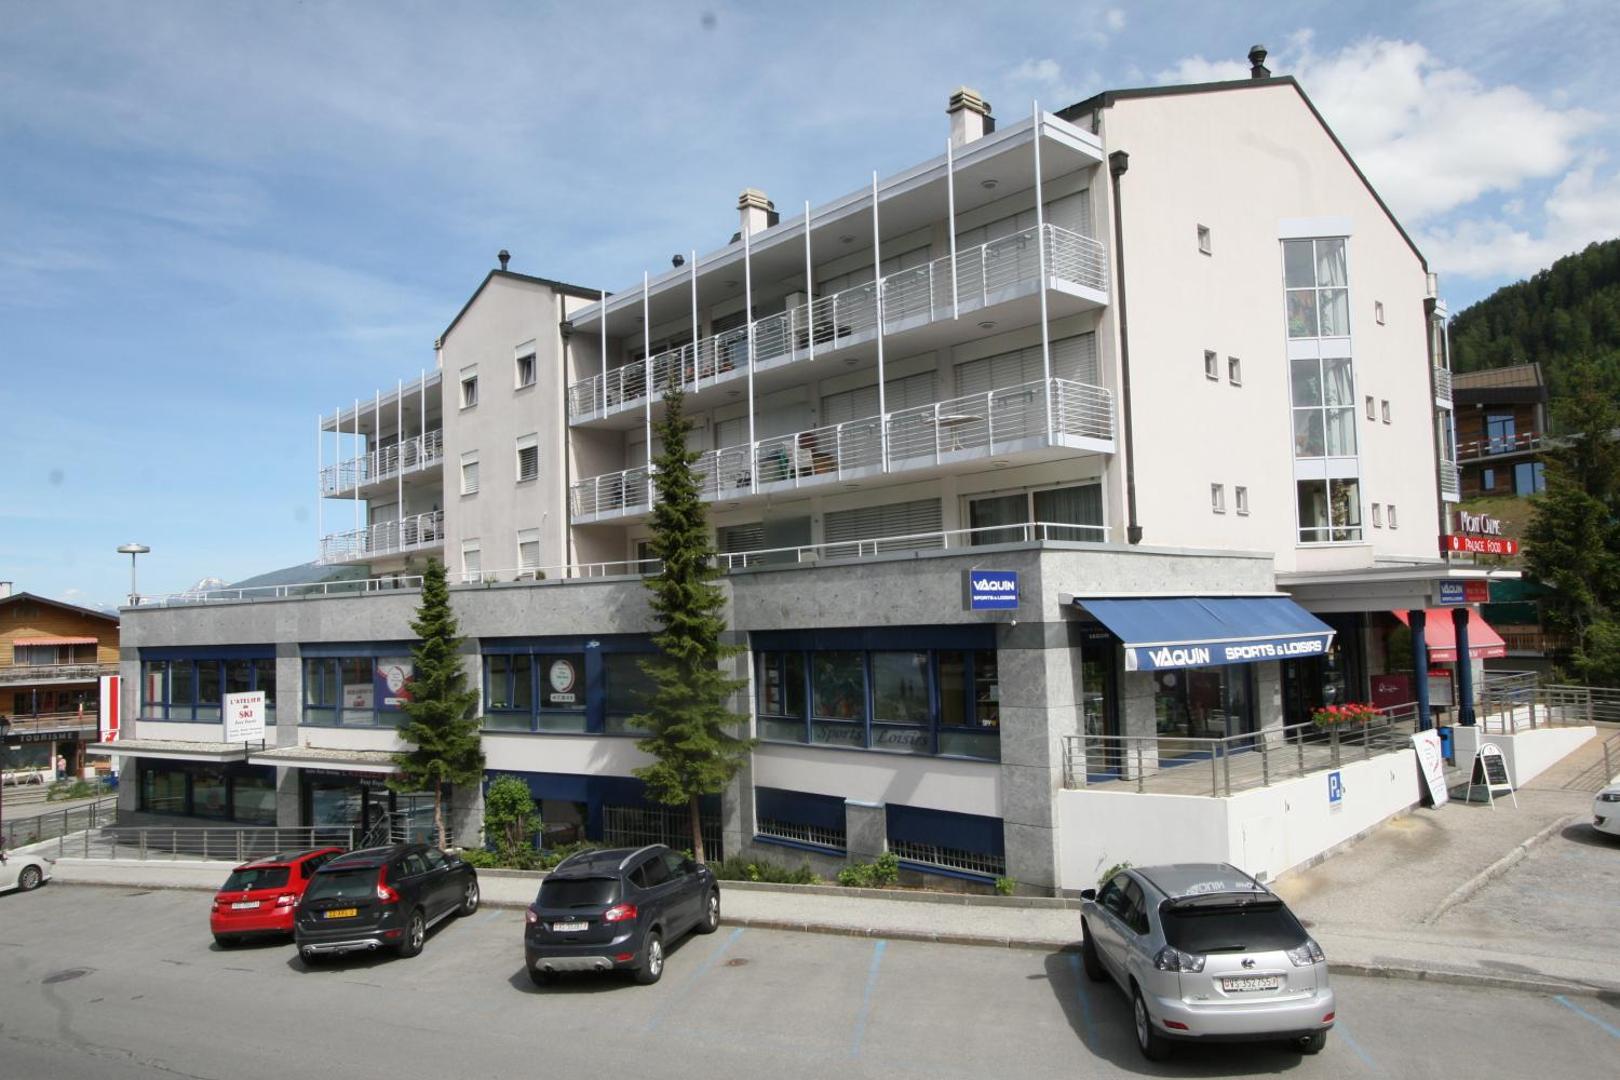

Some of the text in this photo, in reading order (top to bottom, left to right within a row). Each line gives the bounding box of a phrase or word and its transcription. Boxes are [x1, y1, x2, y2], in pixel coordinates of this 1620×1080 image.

[1465, 538, 1502, 553] PALACE FOOD
[973, 578, 1015, 591] VAQUIN
[1149, 640, 1322, 667] VAQUIN SPORTS & LOISIRS
[239, 710, 253, 718] SKI
[20, 732, 73, 742] TOURISME
[817, 725, 929, 747] Sports Loisirs
[1330, 776, 1338, 798] P
